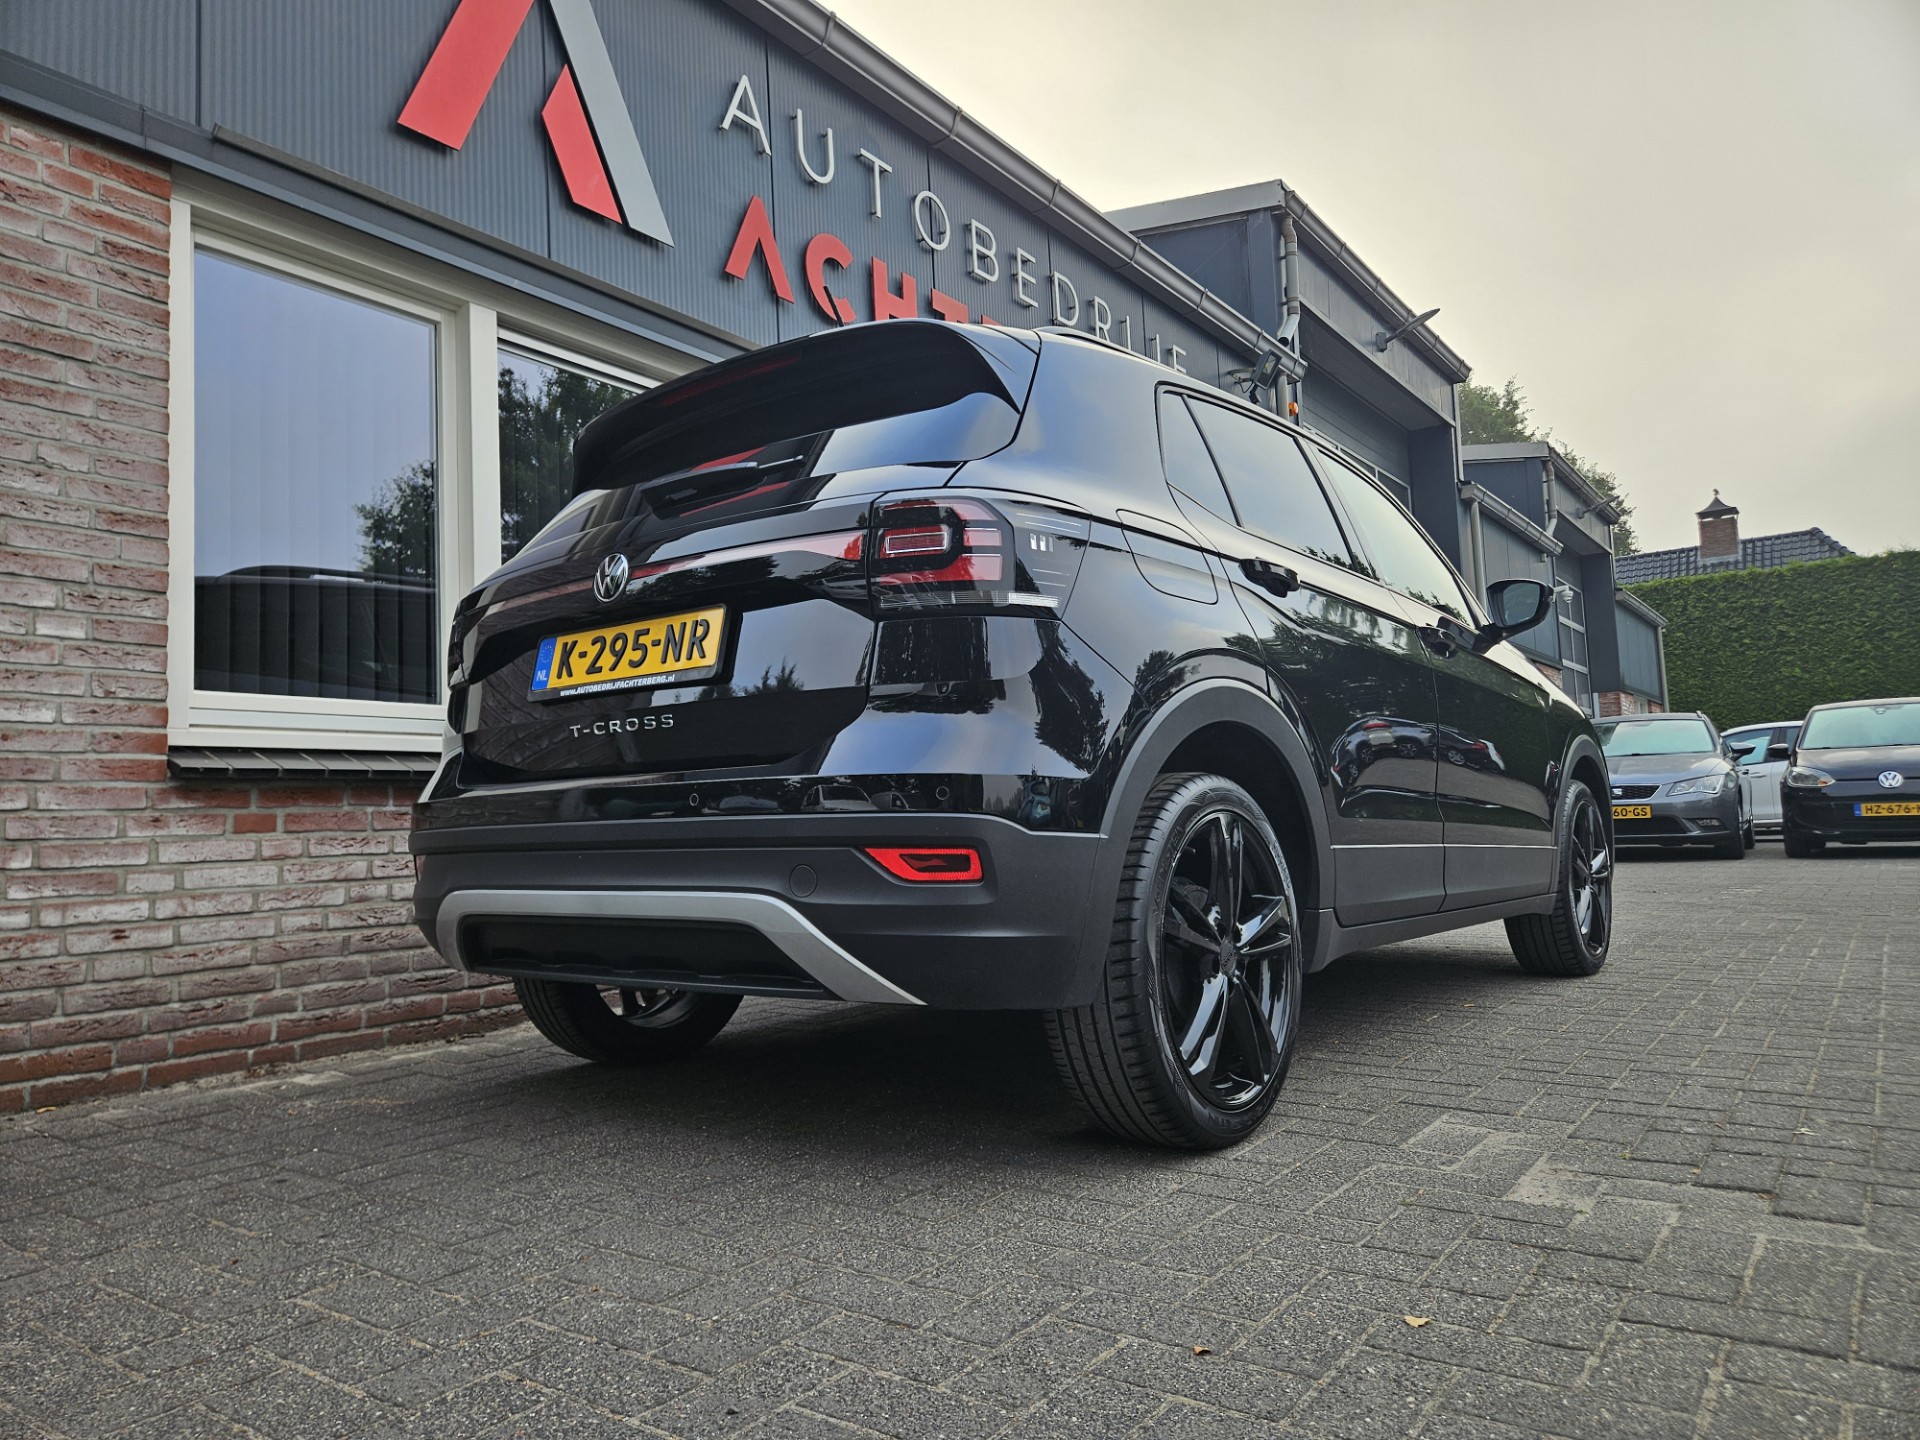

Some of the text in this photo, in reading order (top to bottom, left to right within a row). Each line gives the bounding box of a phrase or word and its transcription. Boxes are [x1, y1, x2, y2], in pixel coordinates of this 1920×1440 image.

[556, 618, 710, 680] K-295-NR
[536, 669, 548, 681] NL
[569, 714, 674, 738] T-CROSS
